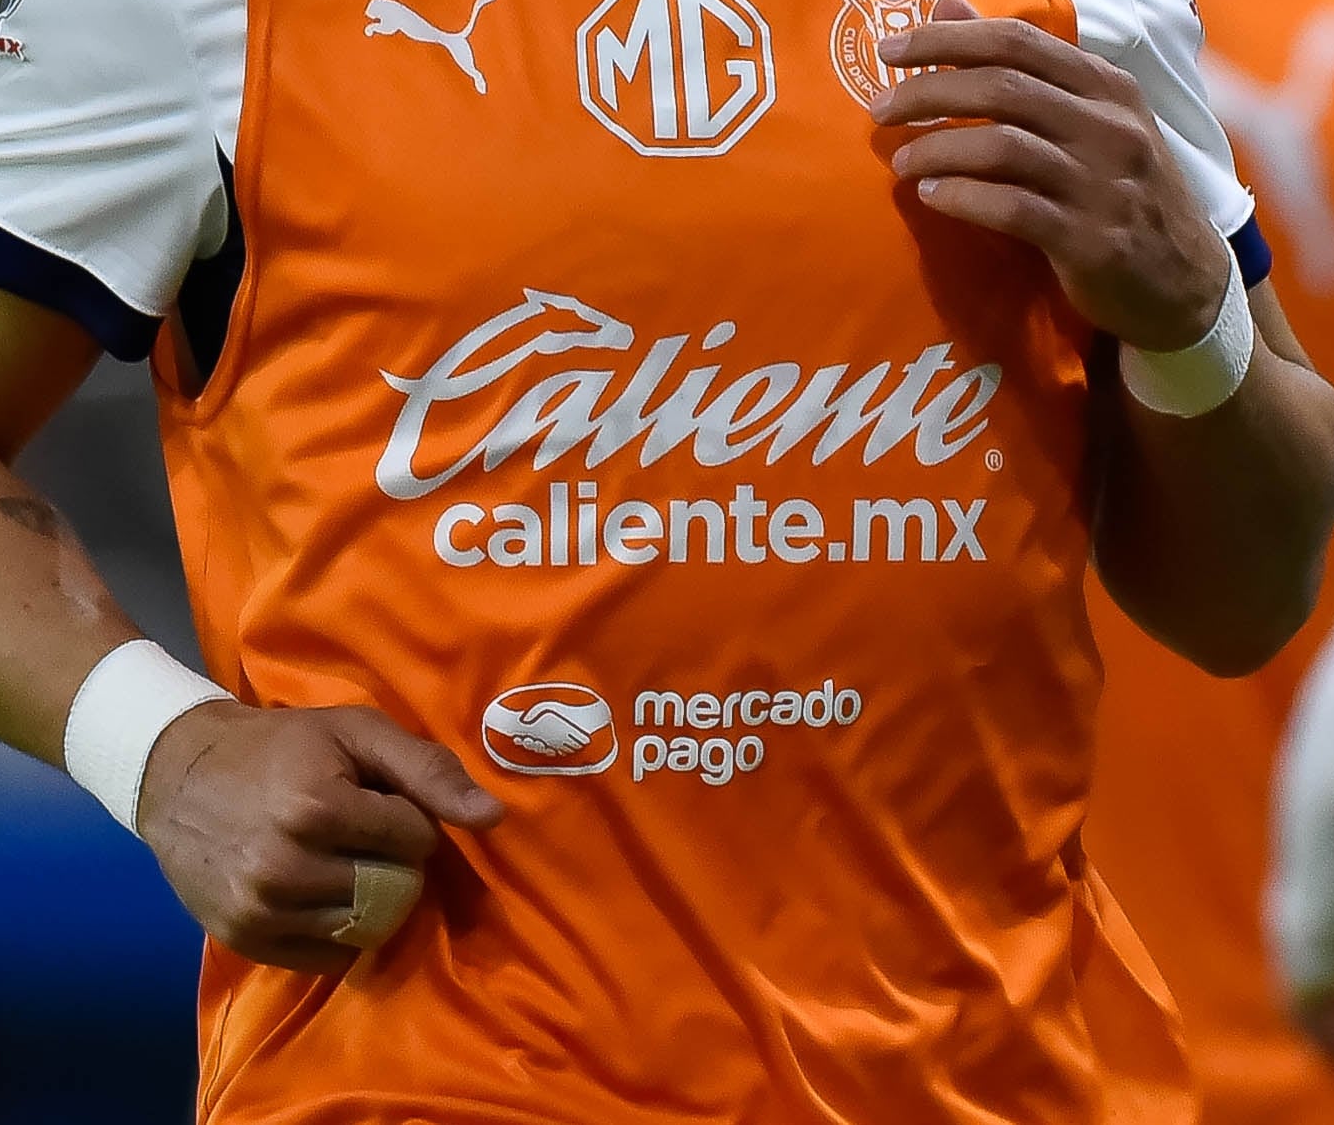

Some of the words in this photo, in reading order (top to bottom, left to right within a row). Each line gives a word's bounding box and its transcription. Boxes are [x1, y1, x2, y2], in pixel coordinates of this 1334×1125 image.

[841, 27, 856, 63] CLUB
[375, 287, 1003, 500] Caliente
[433, 481, 988, 567] caliente.mx
[633, 678, 862, 729] mercado
[633, 734, 765, 786] pago
